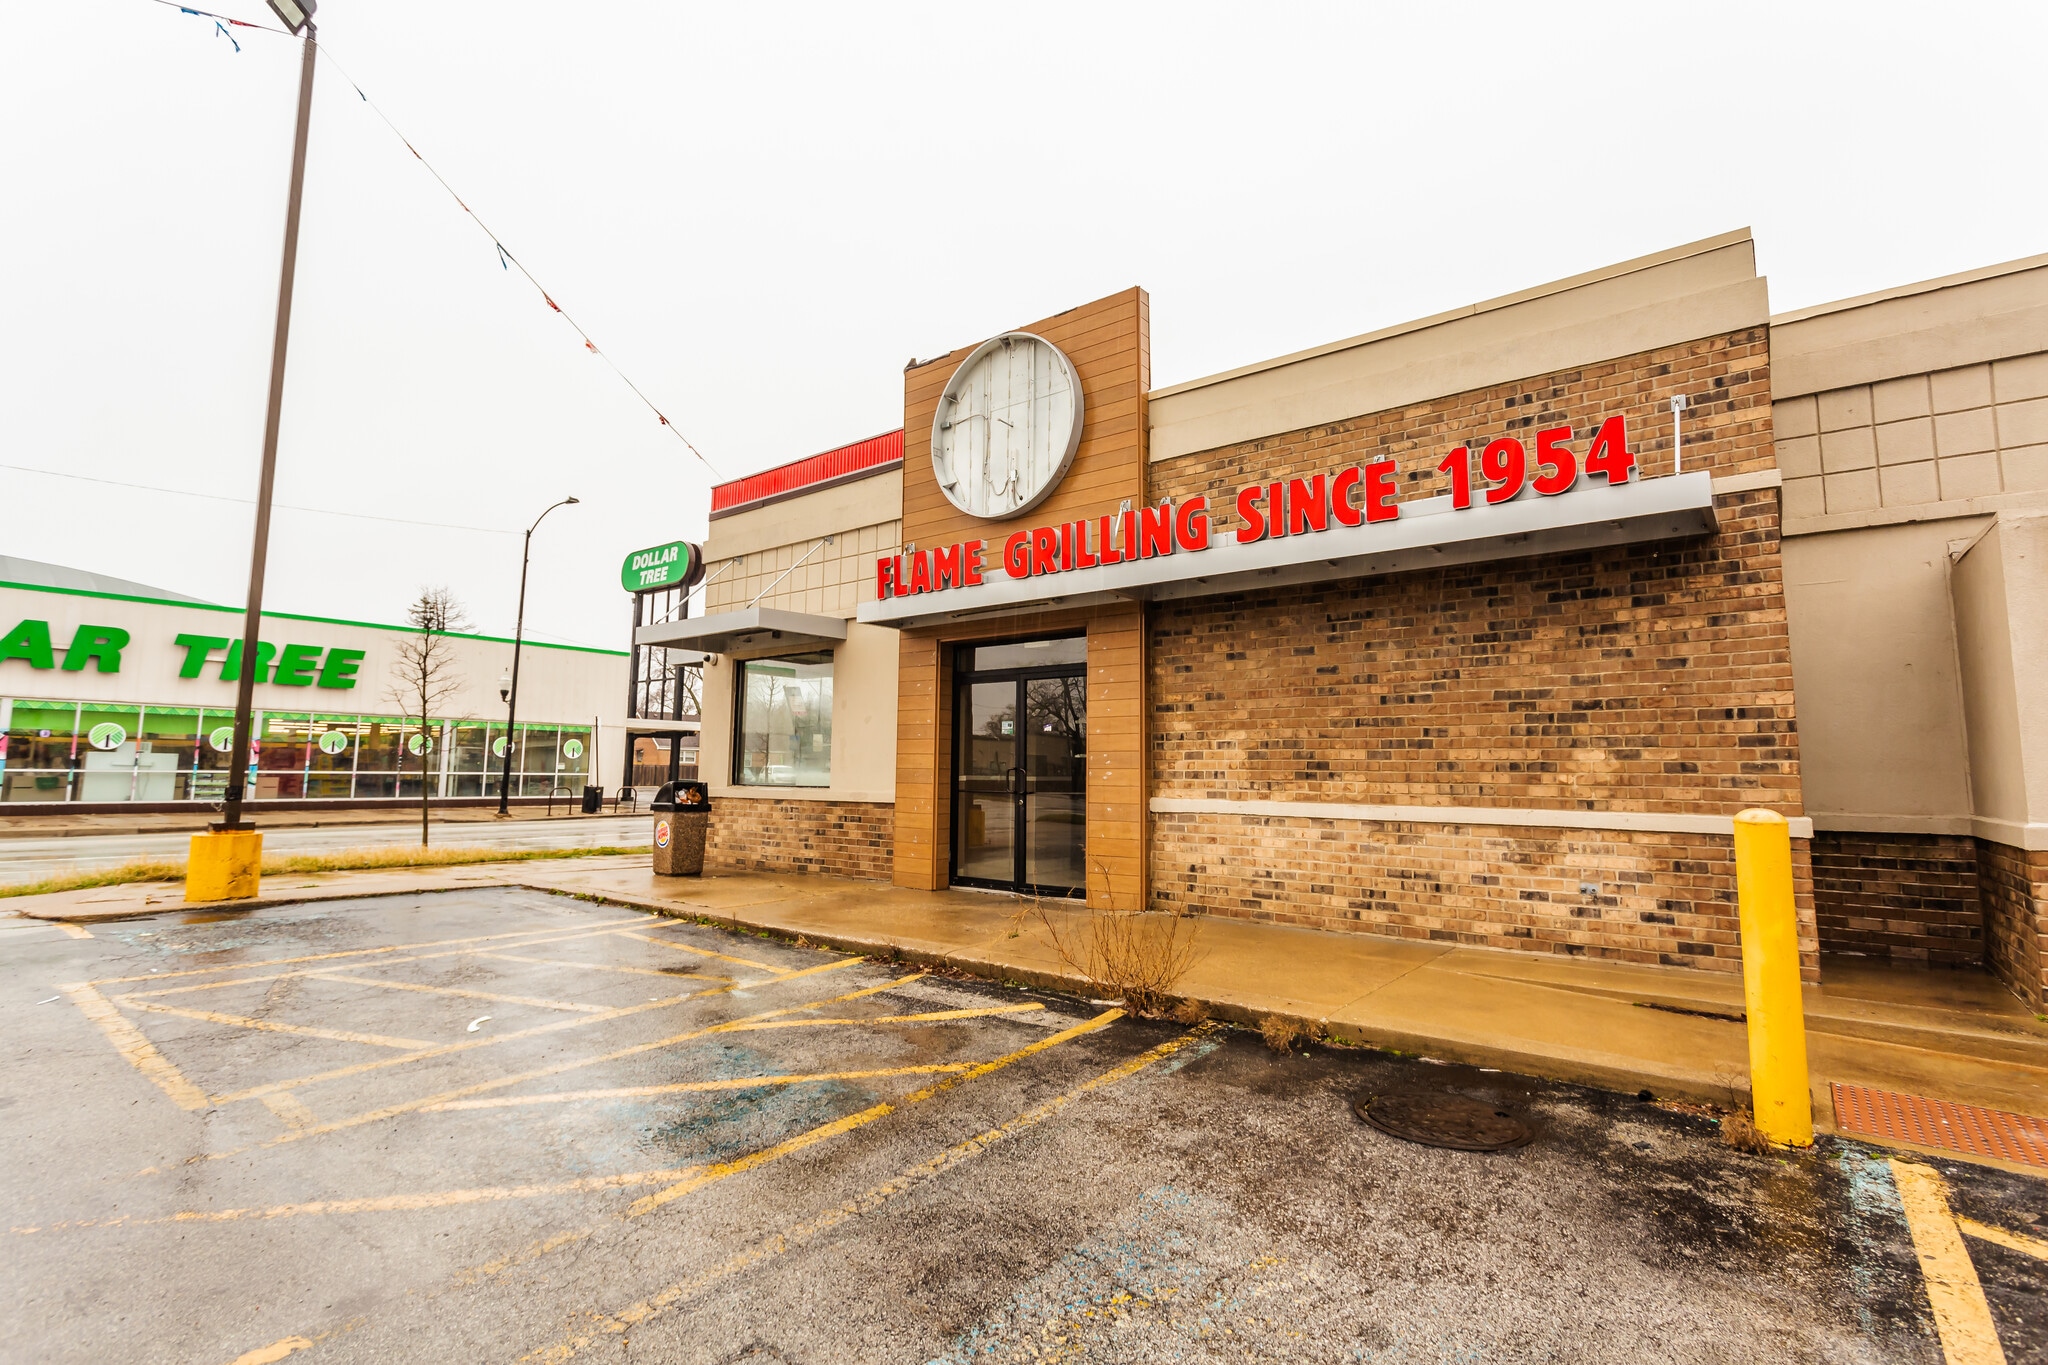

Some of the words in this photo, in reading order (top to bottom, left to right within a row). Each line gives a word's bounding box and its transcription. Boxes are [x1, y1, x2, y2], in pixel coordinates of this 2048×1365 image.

[877, 539, 987, 600] FLAME
[1003, 495, 1212, 580] GRILLING
[1235, 458, 1400, 544] SINCE
[1436, 414, 1637, 511] 1954
[632, 546, 679, 570] DOLLAR
[640, 566, 669, 585] TREE
[174, 633, 367, 690] TREE
